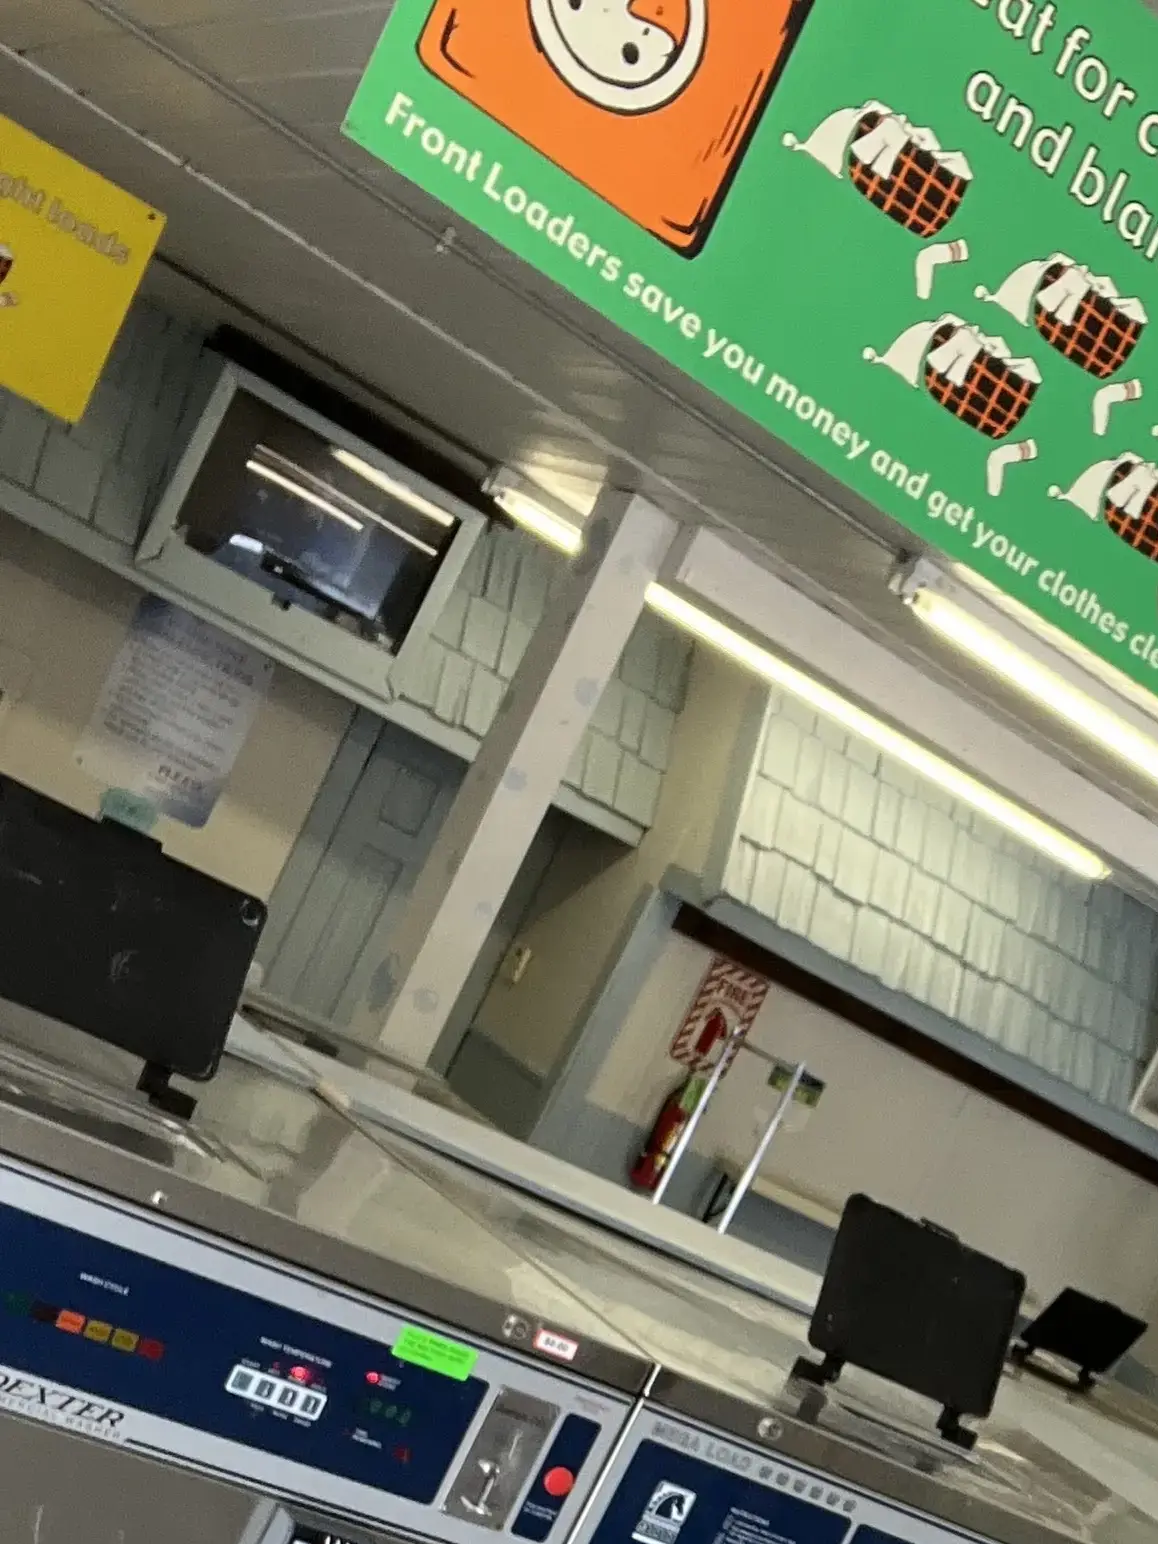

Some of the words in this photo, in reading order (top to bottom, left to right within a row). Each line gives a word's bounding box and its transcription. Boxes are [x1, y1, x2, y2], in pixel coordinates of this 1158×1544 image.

[972, 0, 1057, 54] at
[1055, 25, 1137, 120] for
[965, 70, 1074, 177] and
[384, 91, 483, 182] Front
[483, 162, 622, 282] Loaders
[623, 271, 702, 339] save
[702, 328, 766, 384] you
[765, 373, 870, 460] money
[869, 449, 931, 500] and
[927, 490, 974, 533] get
[972, 521, 1040, 577] your
[1037, 570, 1130, 643] clothes
